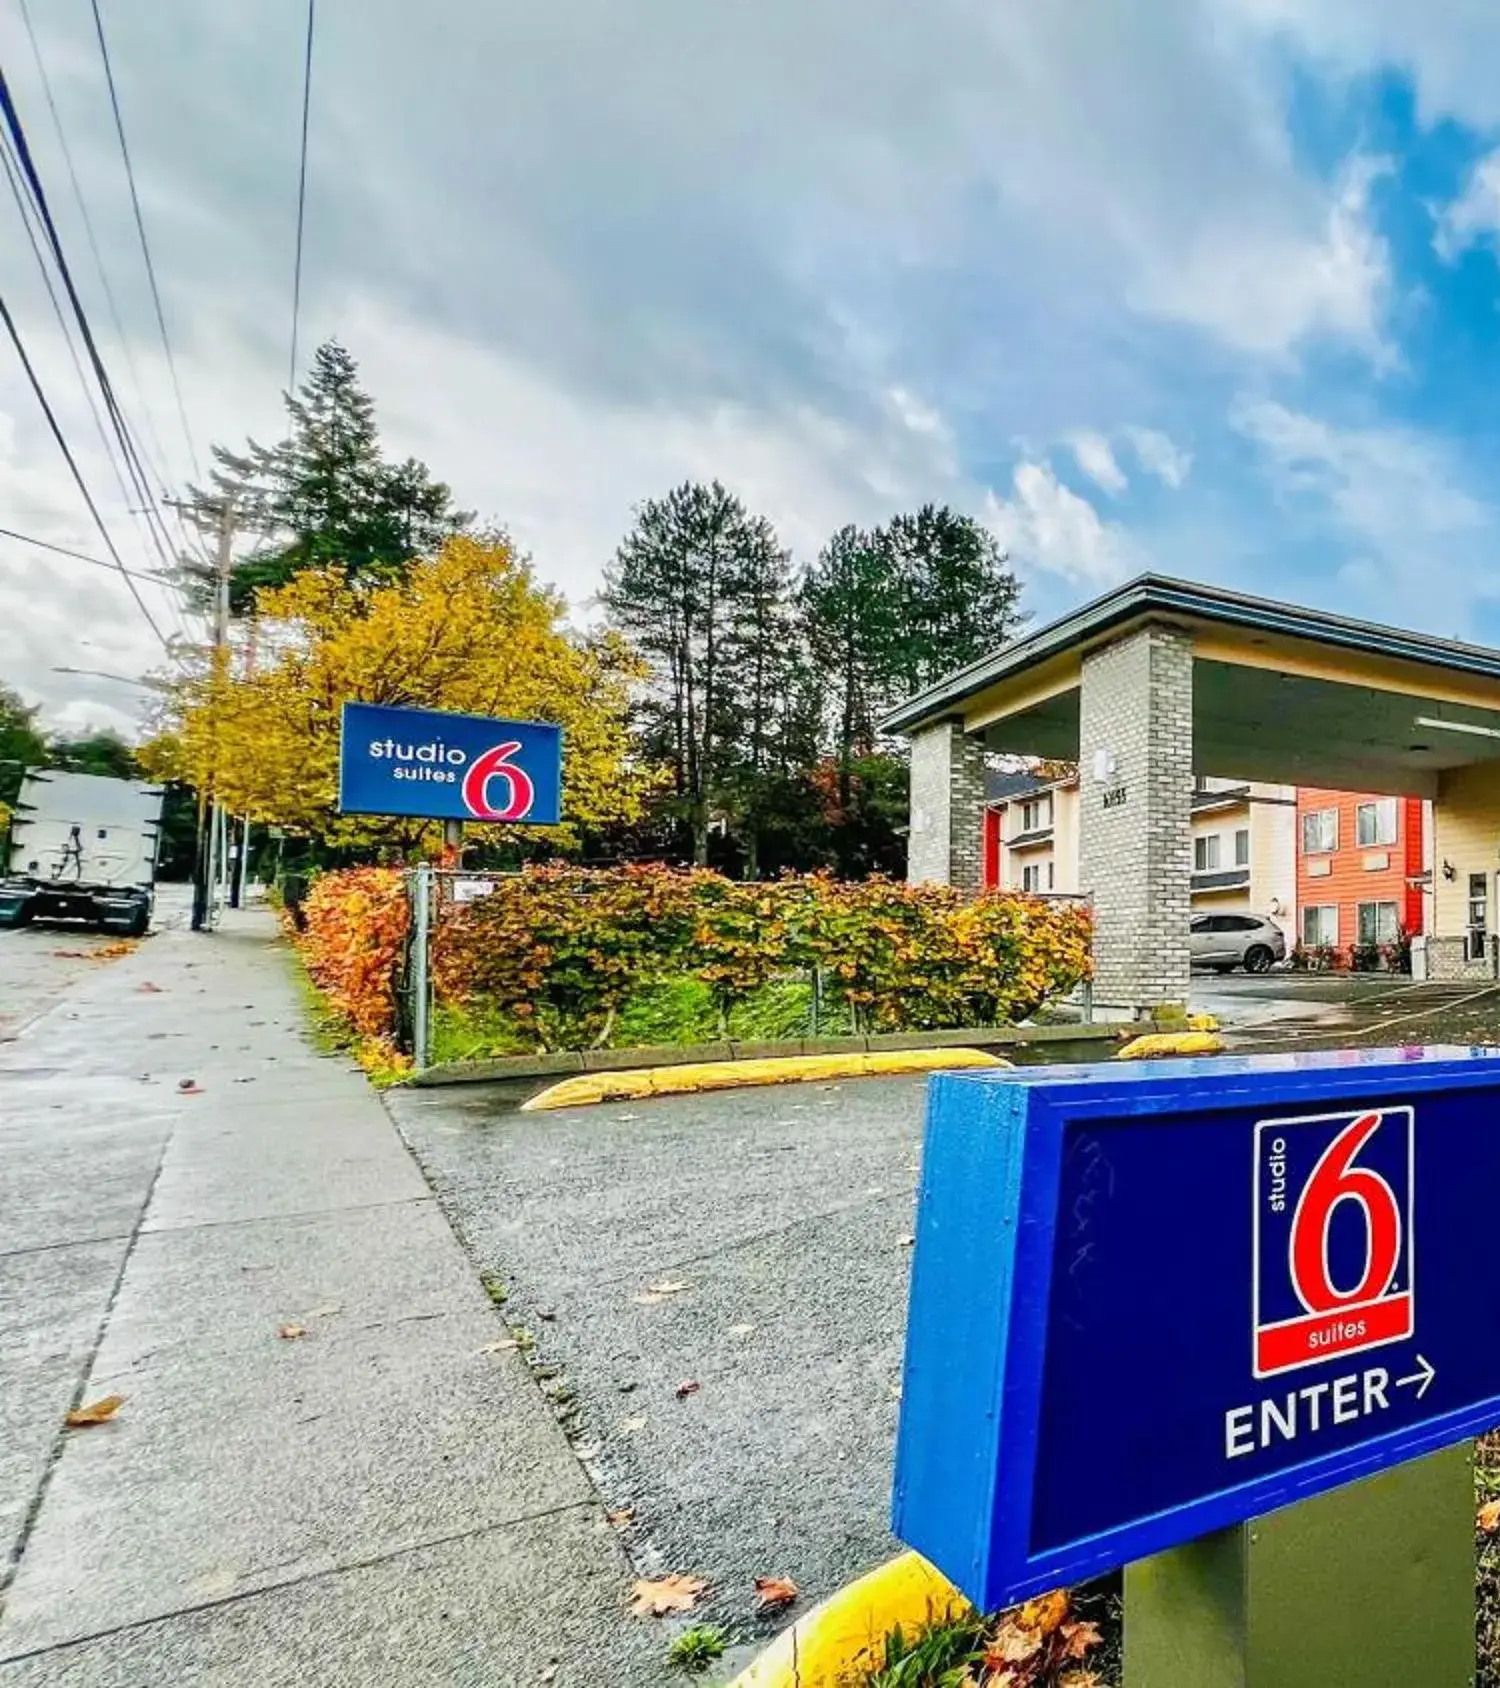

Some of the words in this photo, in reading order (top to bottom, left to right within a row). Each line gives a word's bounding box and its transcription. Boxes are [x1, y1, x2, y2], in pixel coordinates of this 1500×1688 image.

[368, 736, 466, 765] studio
[393, 766, 456, 783] suites
[461, 741, 534, 820] 6
[1268, 1137, 1286, 1212] studio
[1289, 1112, 1401, 1315] 6
[1308, 1317, 1366, 1349] suites
[1225, 1367, 1390, 1459] ENTER
